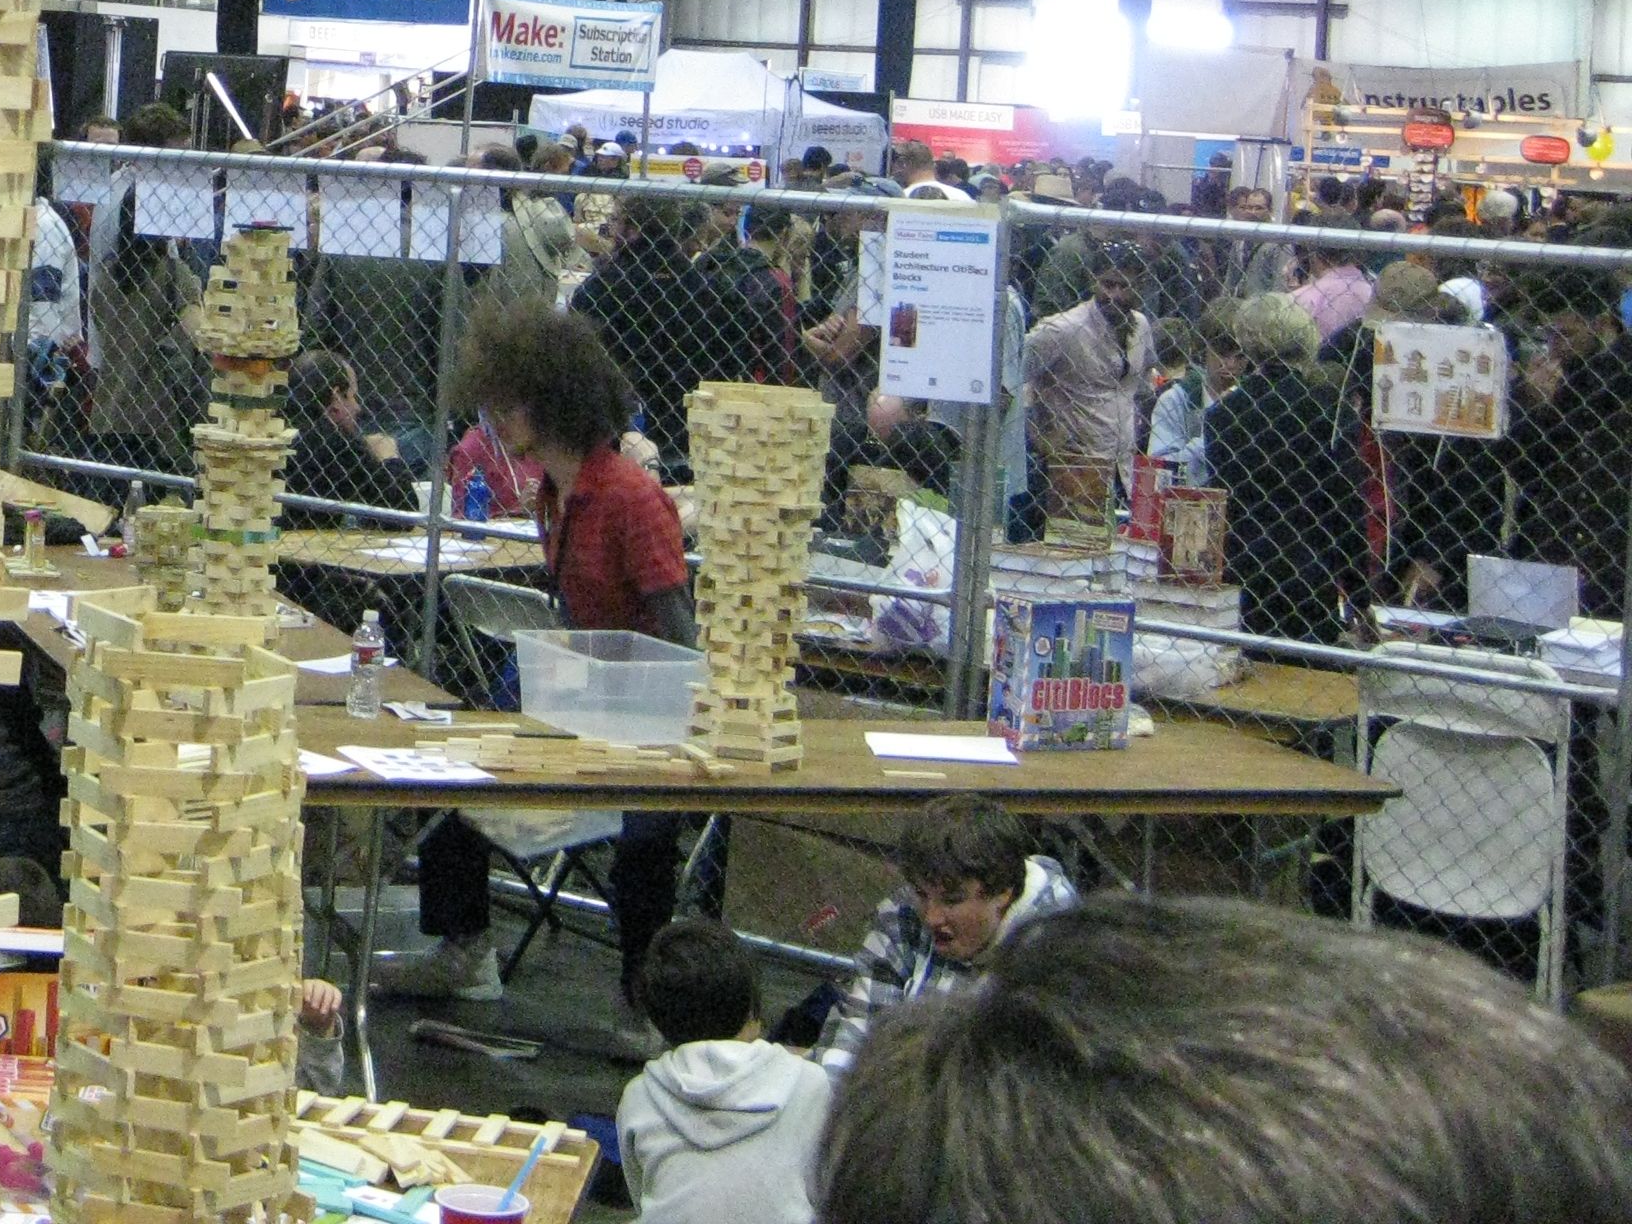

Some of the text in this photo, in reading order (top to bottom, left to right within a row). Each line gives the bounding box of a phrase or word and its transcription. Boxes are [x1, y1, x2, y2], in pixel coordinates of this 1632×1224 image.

[491, 11, 566, 49] Make:
[489, 46, 562, 64] mkezine.com
[590, 46, 632, 63] Station
[928, 108, 1002, 123] USB MADE EASY
[667, 117, 710, 130] studio
[894, 249, 929, 259] Student
[894, 262, 949, 272] Architecture
[893, 273, 921, 282] Blocks
